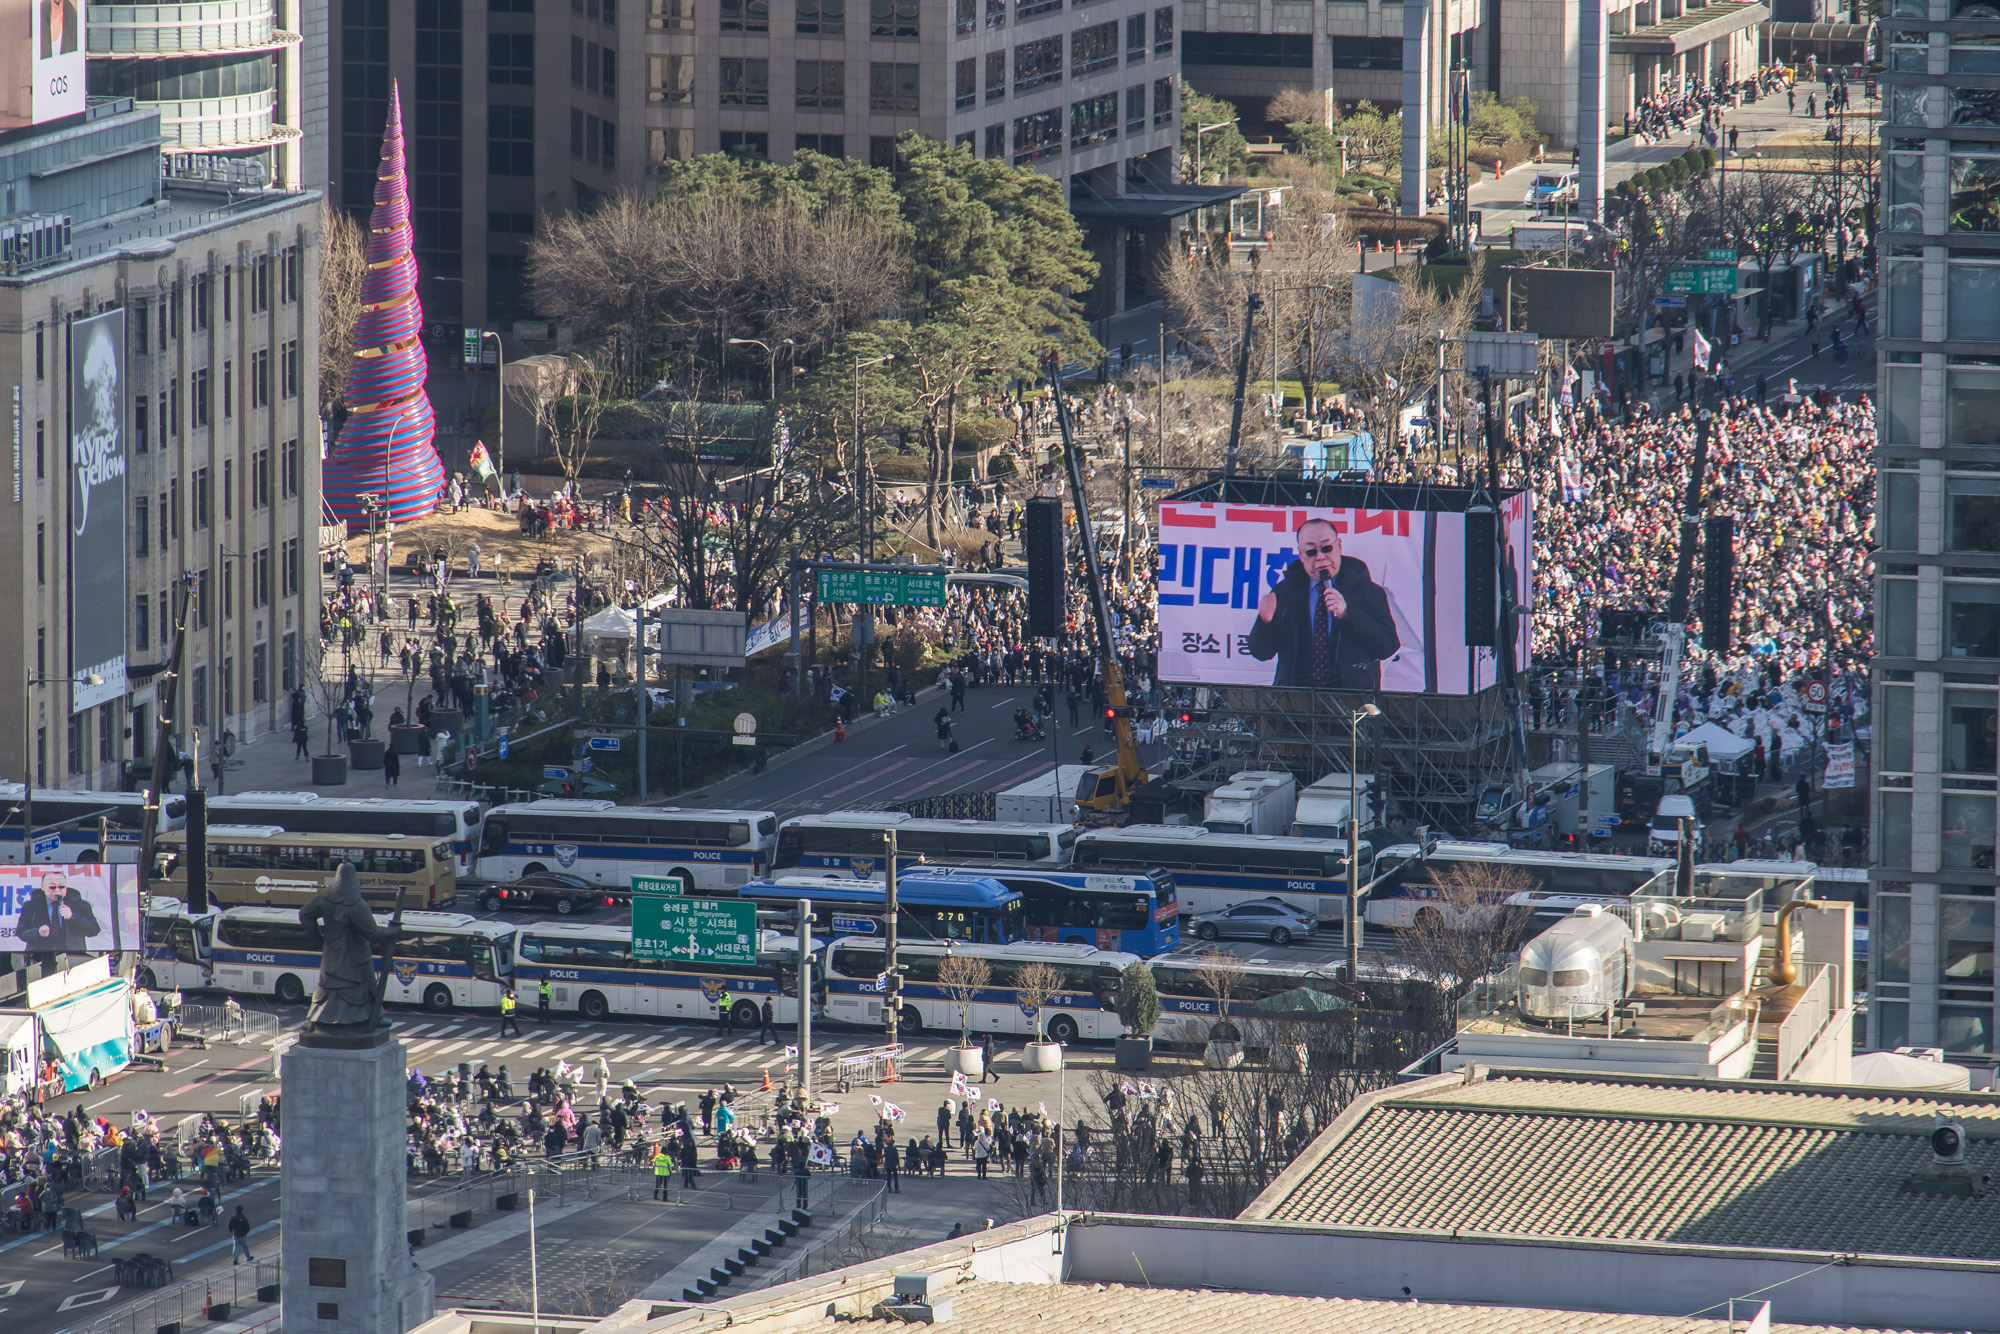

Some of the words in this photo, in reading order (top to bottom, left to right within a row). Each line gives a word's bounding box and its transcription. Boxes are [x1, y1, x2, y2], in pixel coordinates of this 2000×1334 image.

[50, 75, 68, 96] COS
[73, 428, 119, 468] hyper
[77, 453, 125, 536] yellow
[907, 579, 941, 589] 서대문역
[1182, 632, 1220, 653] 장소
[1811, 686, 1822, 698] 50
[526, 846, 543, 854] 경찰
[693, 851, 721, 860] POLICE
[823, 857, 840, 866] 경찰
[937, 868, 954, 876] EV
[378, 878, 417, 886] Limousine
[637, 881, 677, 892] 세종대로사거리
[1287, 881, 1316, 890] POLICE
[662, 902, 689, 914] 숭례문
[693, 910, 731, 919] Sungnyemun
[937, 912, 964, 922] 270
[674, 917, 698, 927] 시청
[706, 919, 737, 929] 시의회
[673, 927, 685, 935] City
[702, 928, 714, 936] City
[634, 938, 668, 949] 종로1가
[715, 943, 750, 954] 서대문역
[634, 948, 653, 956] Jongno
[246, 953, 275, 963] POLICE
[427, 964, 446, 973] 경찰
[550, 969, 579, 979] POLICE
[737, 981, 755, 990] 경찰
[1054, 995, 1072, 1005] 경찰
[1179, 1001, 1210, 1012] POLICE
